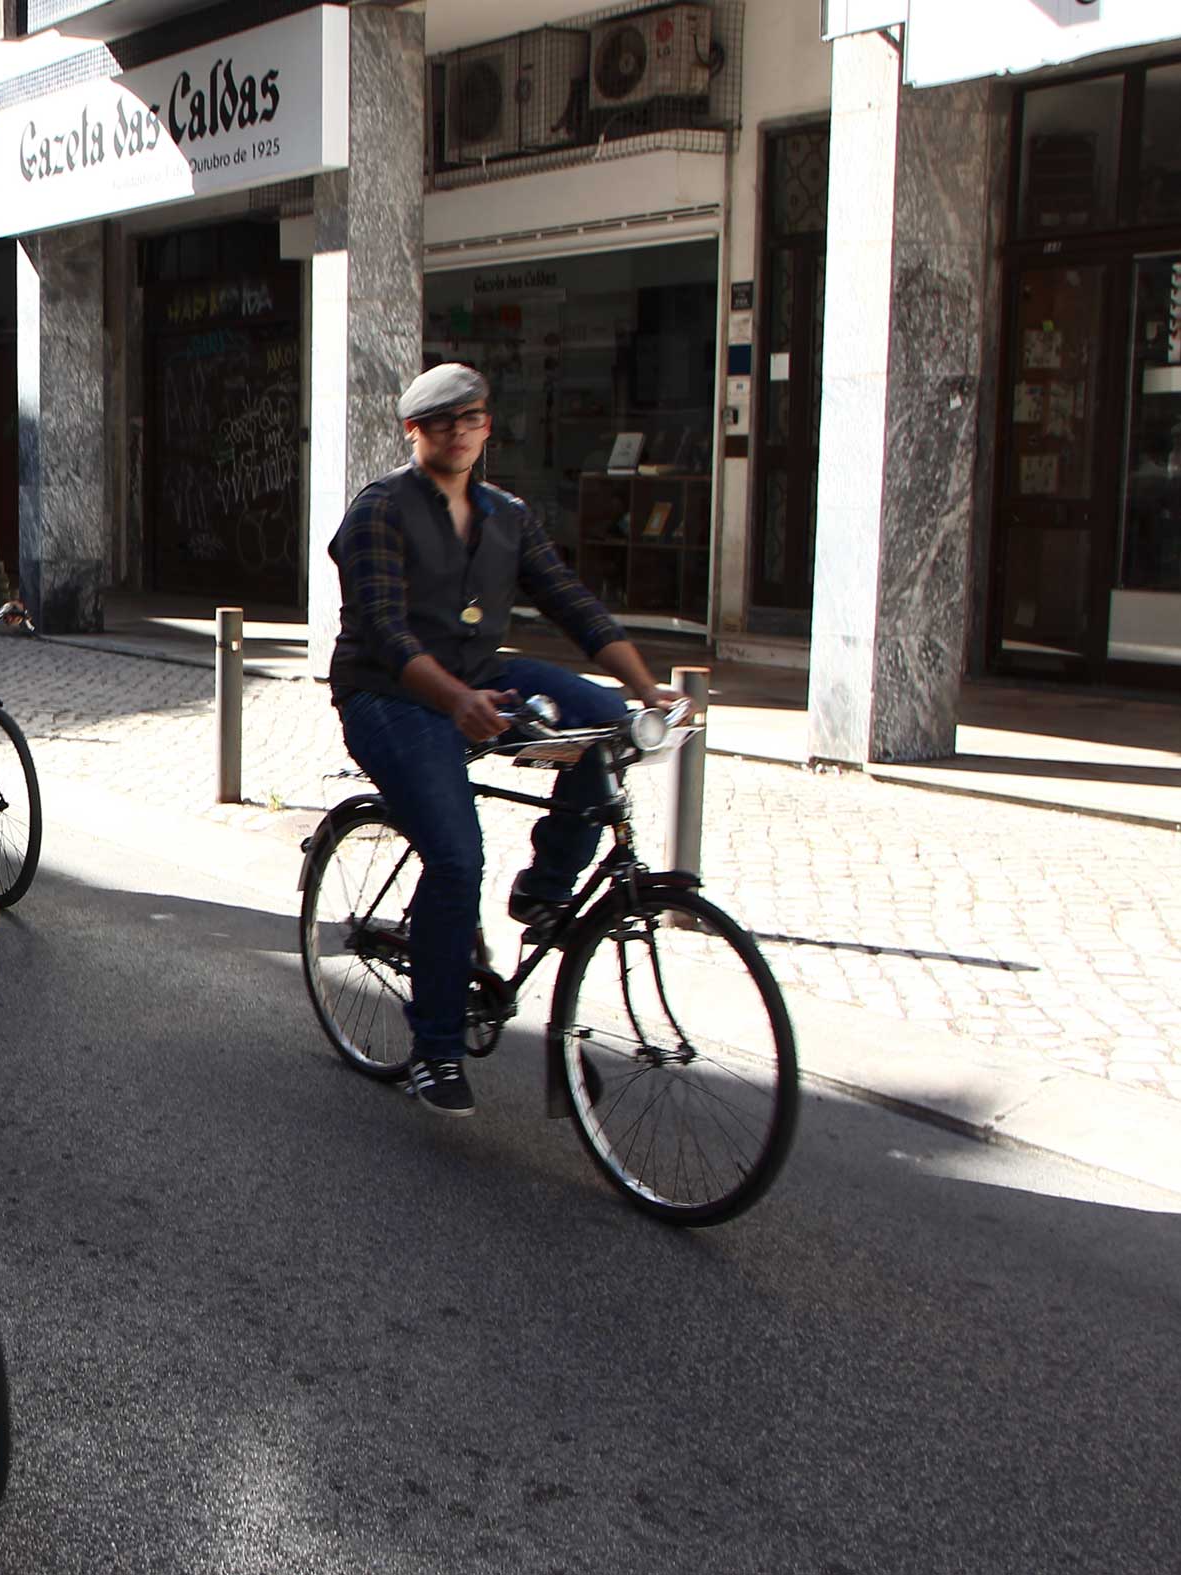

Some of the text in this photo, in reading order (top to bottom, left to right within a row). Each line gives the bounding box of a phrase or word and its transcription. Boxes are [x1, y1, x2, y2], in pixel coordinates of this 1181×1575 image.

[20, 58, 280, 182] Gazeta das Caldas
[190, 153, 230, 174] Outubro
[234, 148, 247, 164] de
[252, 138, 280, 160] 1925
